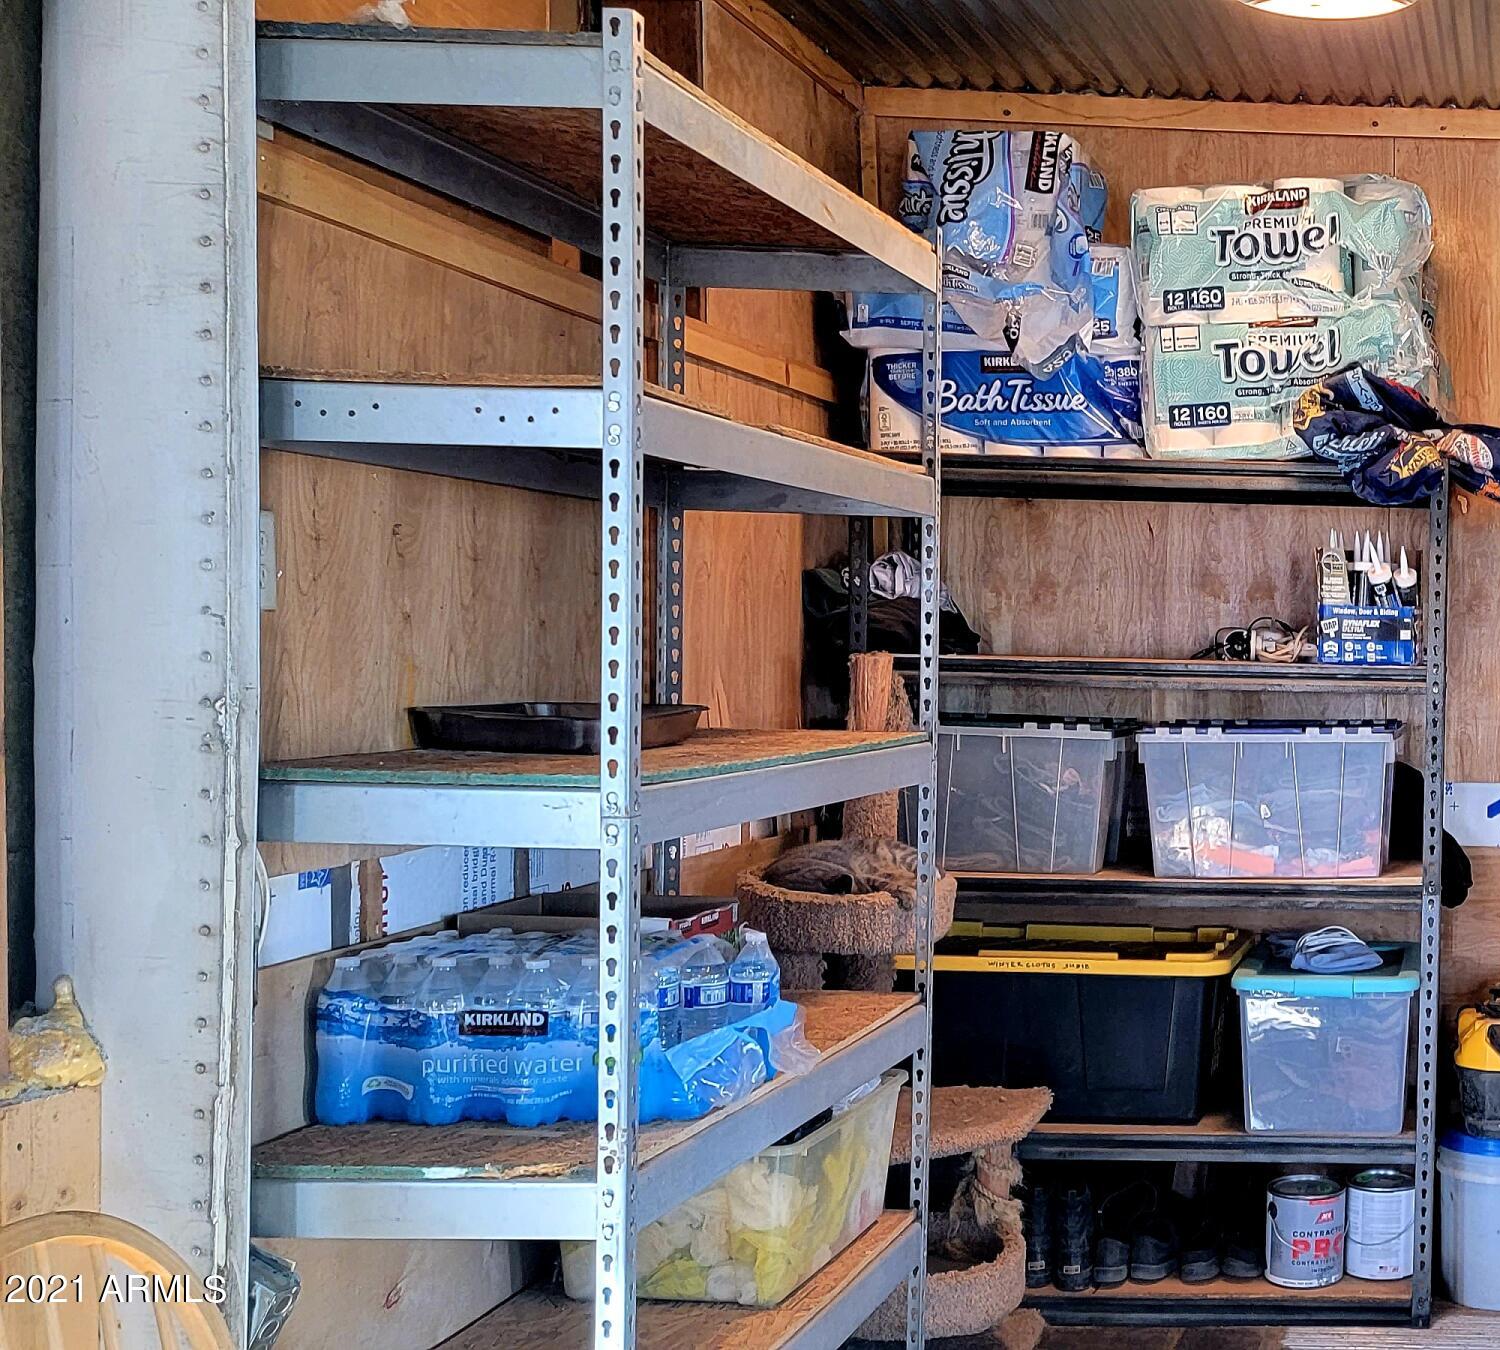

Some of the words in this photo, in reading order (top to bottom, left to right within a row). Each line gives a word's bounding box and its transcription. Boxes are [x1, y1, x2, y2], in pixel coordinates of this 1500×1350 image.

[1250, 188, 1307, 207] KIRKLAND
[1209, 213, 1340, 265] Towel
[1166, 292, 1185, 306] 12
[1190, 288, 1222, 305] 160
[984, 356, 1021, 367] KIRKL
[938, 379, 1007, 414] Bath
[1003, 379, 1087, 412] Tissue
[1173, 407, 1191, 421] 12
[1197, 405, 1228, 421] 160
[974, 418, 991, 427] Soft
[993, 418, 1008, 427] and
[1010, 417, 1052, 427] Absorbent
[1322, 620, 1338, 632] DAP
[1342, 619, 1381, 628] DYNAFLEX
[464, 1012, 545, 1027] KIRKLAND
[422, 1053, 509, 1078] purified
[513, 1055, 585, 1075] water
[437, 1075, 460, 1084] with
[462, 1075, 499, 1084] minerals
